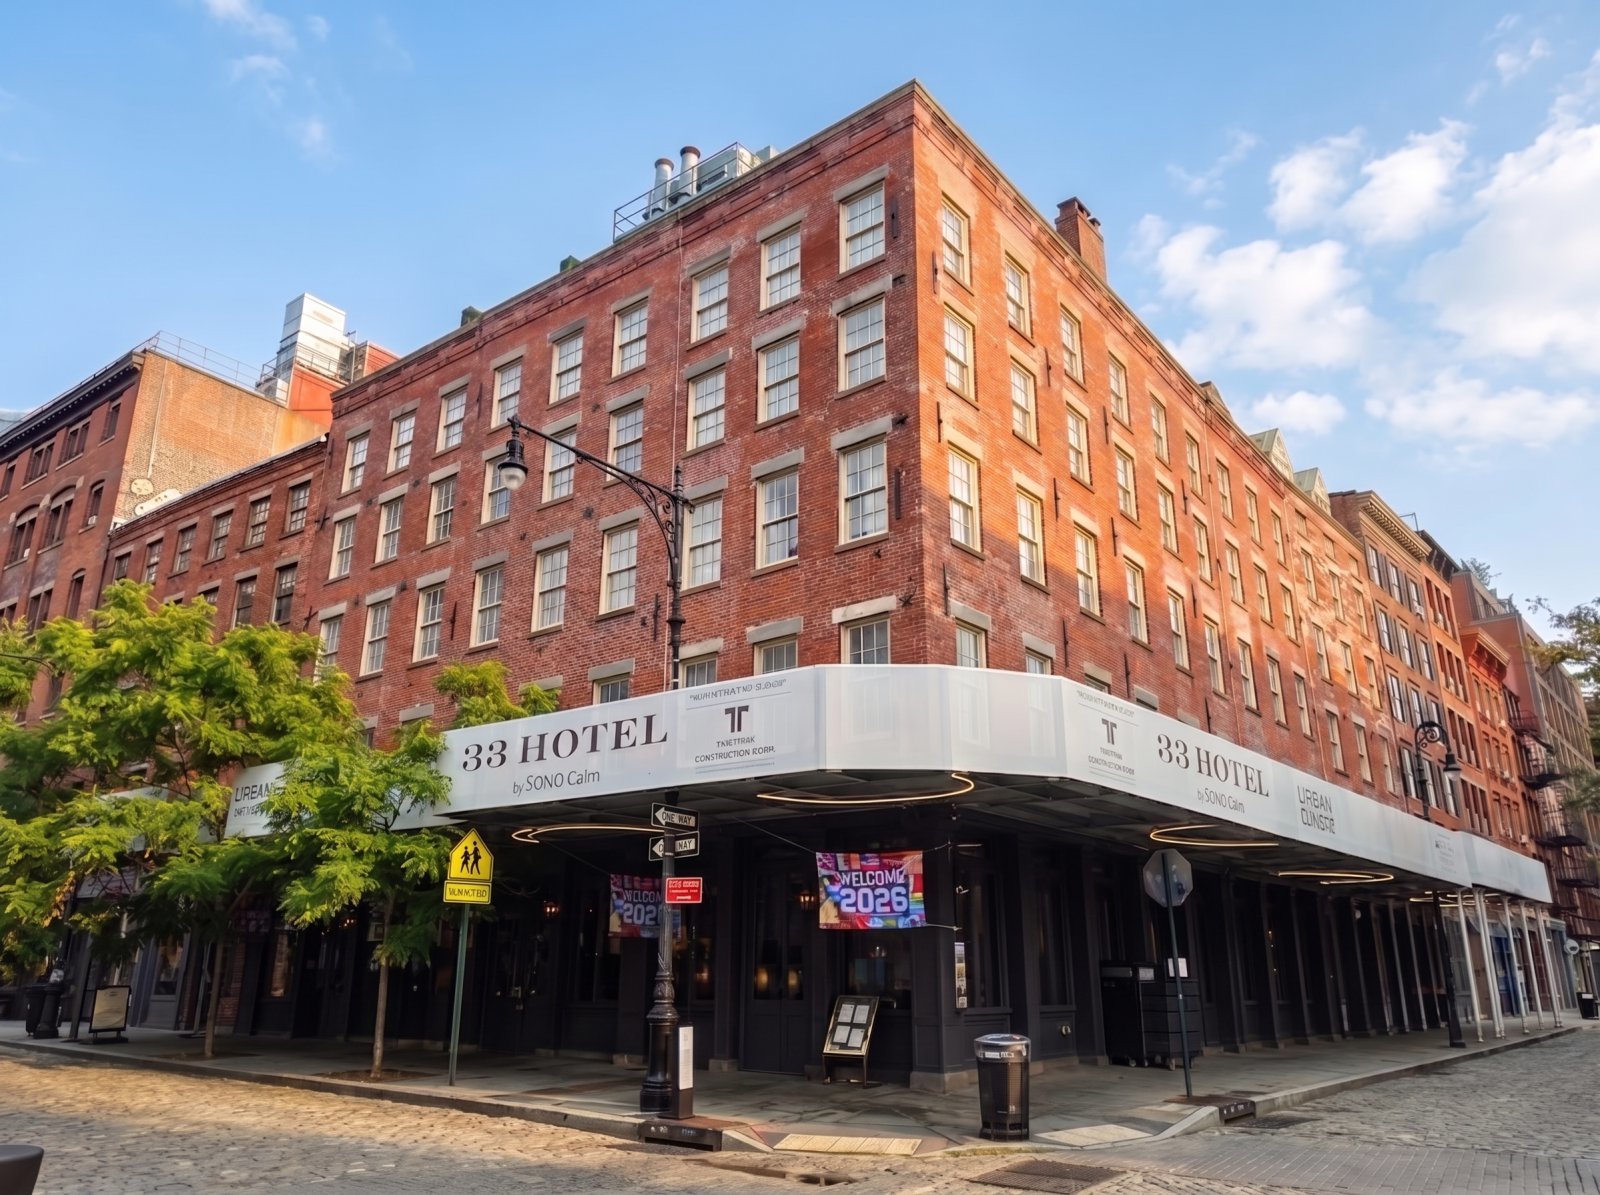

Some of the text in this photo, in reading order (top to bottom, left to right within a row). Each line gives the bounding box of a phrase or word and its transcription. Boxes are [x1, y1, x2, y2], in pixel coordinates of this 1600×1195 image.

[462, 714, 668, 771] 33 HOTEL
[694, 748, 750, 763] CONSTRUCTION
[1157, 733, 1269, 797] 33 HOTEL
[512, 769, 600, 797] by SONO Calm
[1204, 787, 1227, 808] SONO
[1228, 795, 1245, 814] Calm
[1297, 785, 1332, 813] URBAN
[661, 811, 692, 825] ONE WAY
[840, 868, 906, 887] WELCOME
[840, 886, 908, 913] 2026
